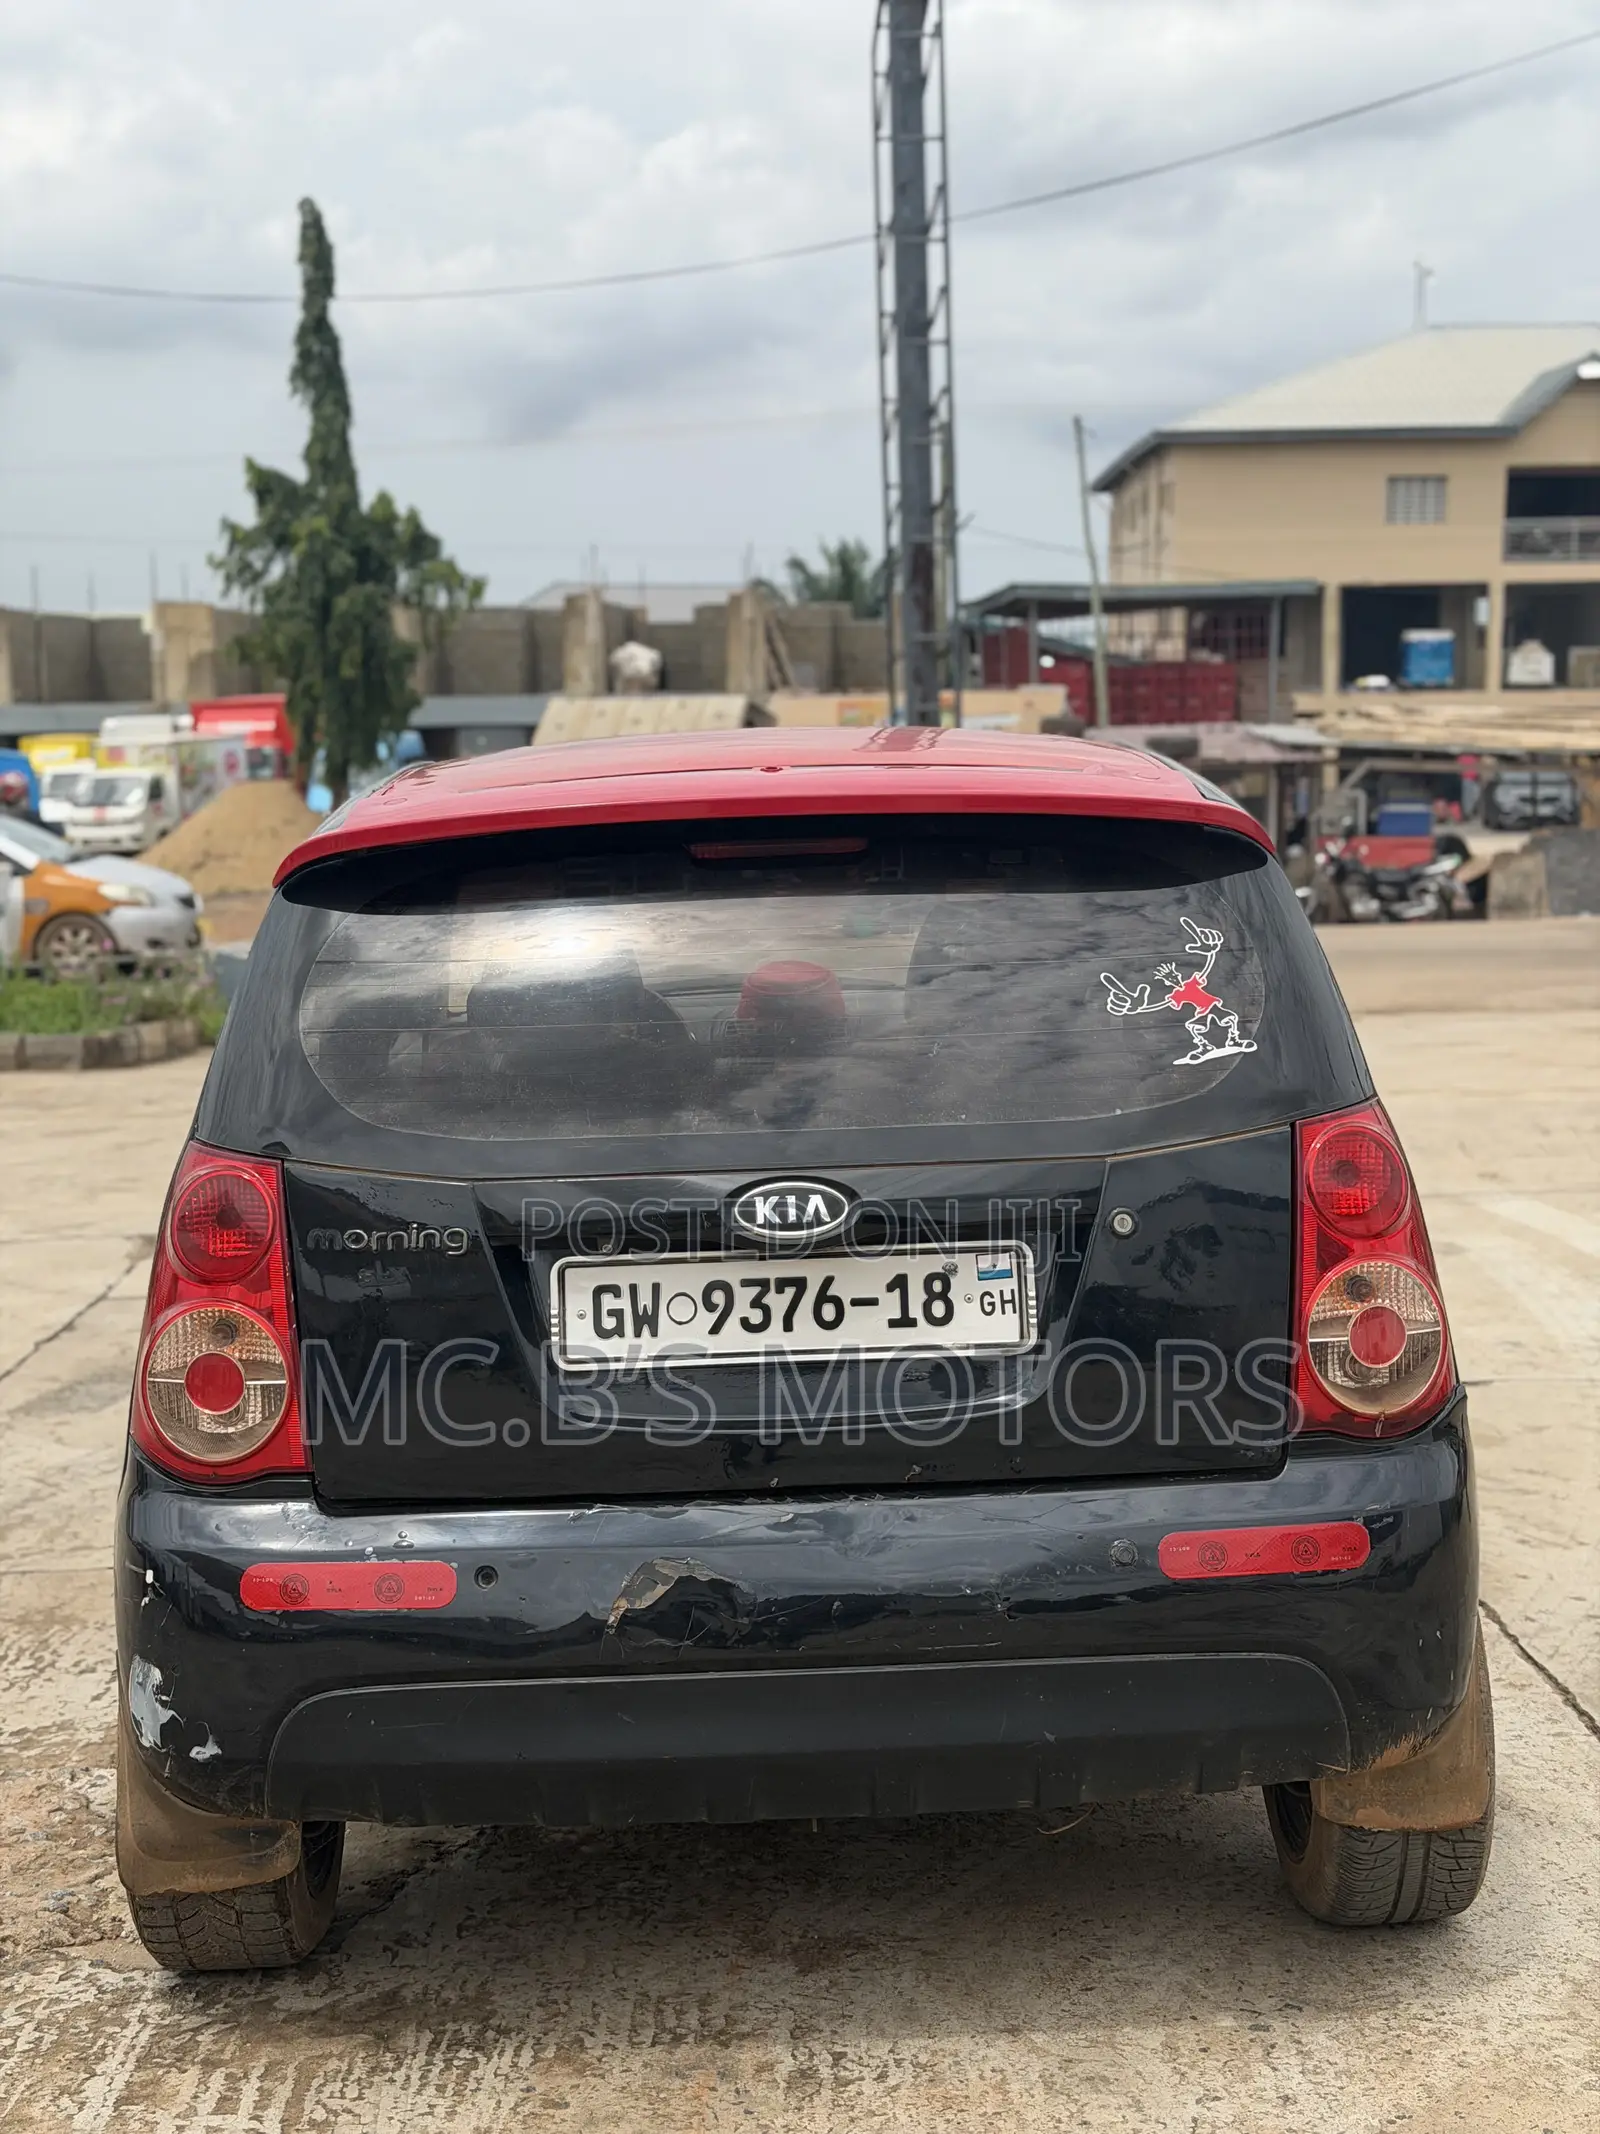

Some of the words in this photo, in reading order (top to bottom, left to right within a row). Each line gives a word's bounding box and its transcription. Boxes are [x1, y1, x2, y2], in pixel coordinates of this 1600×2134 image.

[754, 1194, 832, 1224] KIA
[306, 1223, 470, 1256] morning
[979, 1288, 1017, 1317] GH
